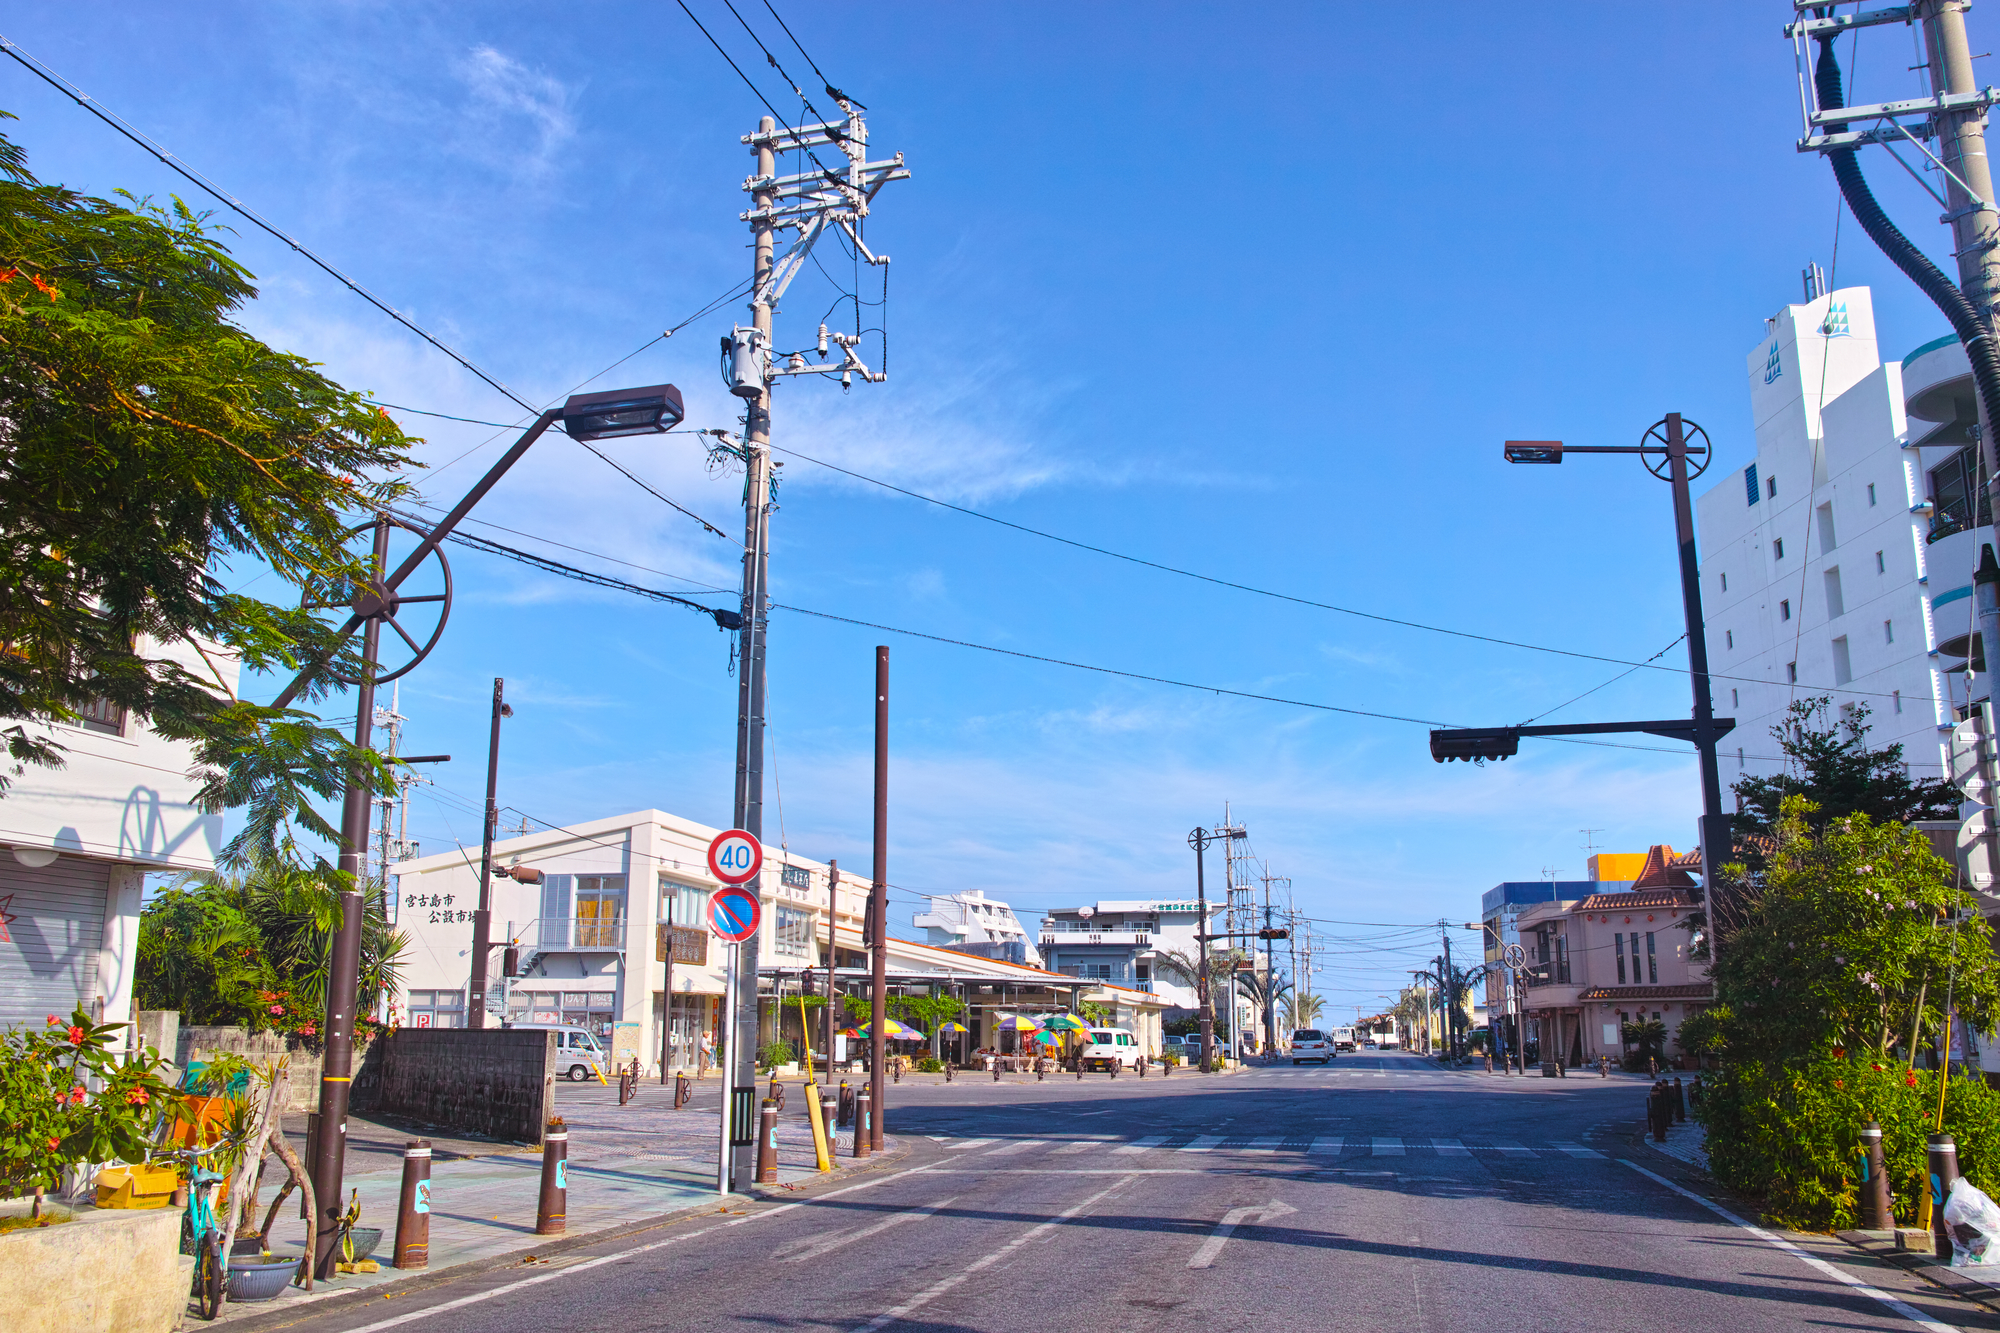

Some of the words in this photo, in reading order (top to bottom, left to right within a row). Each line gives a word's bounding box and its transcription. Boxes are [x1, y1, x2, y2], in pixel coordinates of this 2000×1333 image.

[720, 845, 750, 869] 40
[405, 893, 455, 908] 宮古島市
[418, 1015, 428, 1028] P
